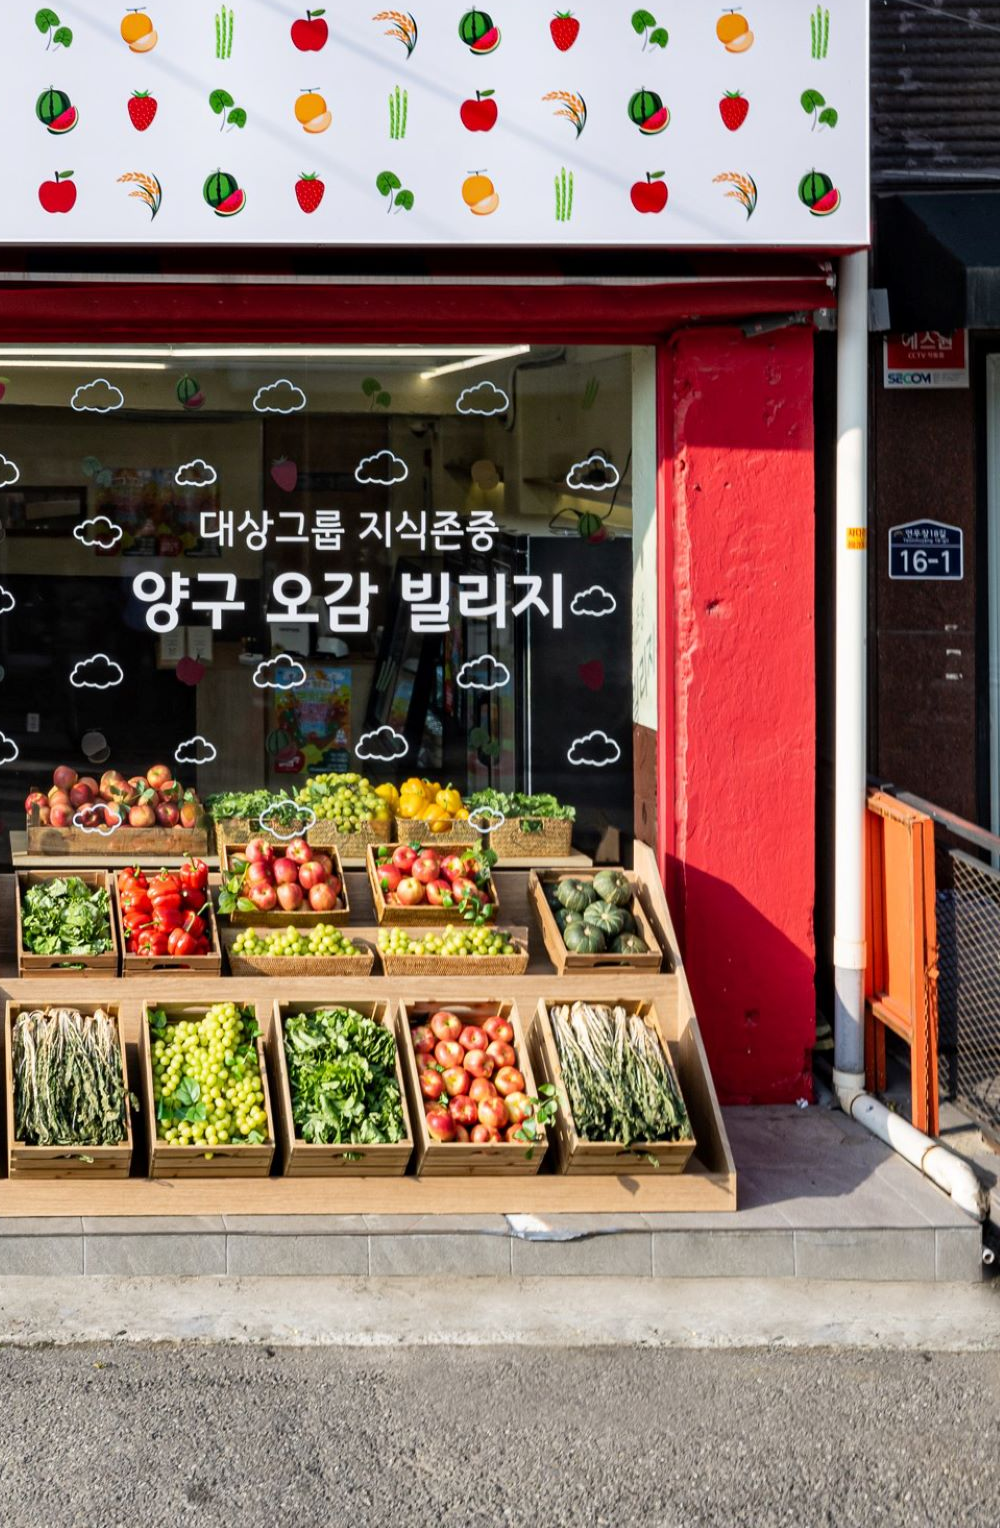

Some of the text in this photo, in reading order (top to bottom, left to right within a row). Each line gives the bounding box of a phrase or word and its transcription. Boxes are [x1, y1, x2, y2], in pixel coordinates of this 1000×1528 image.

[887, 372, 931, 385] SECOM
[200, 510, 345, 552] 대상그룹
[359, 510, 500, 552] 지식존중
[899, 549, 951, 574] 16-1
[132, 571, 563, 633] 양구 오감 빌리지
